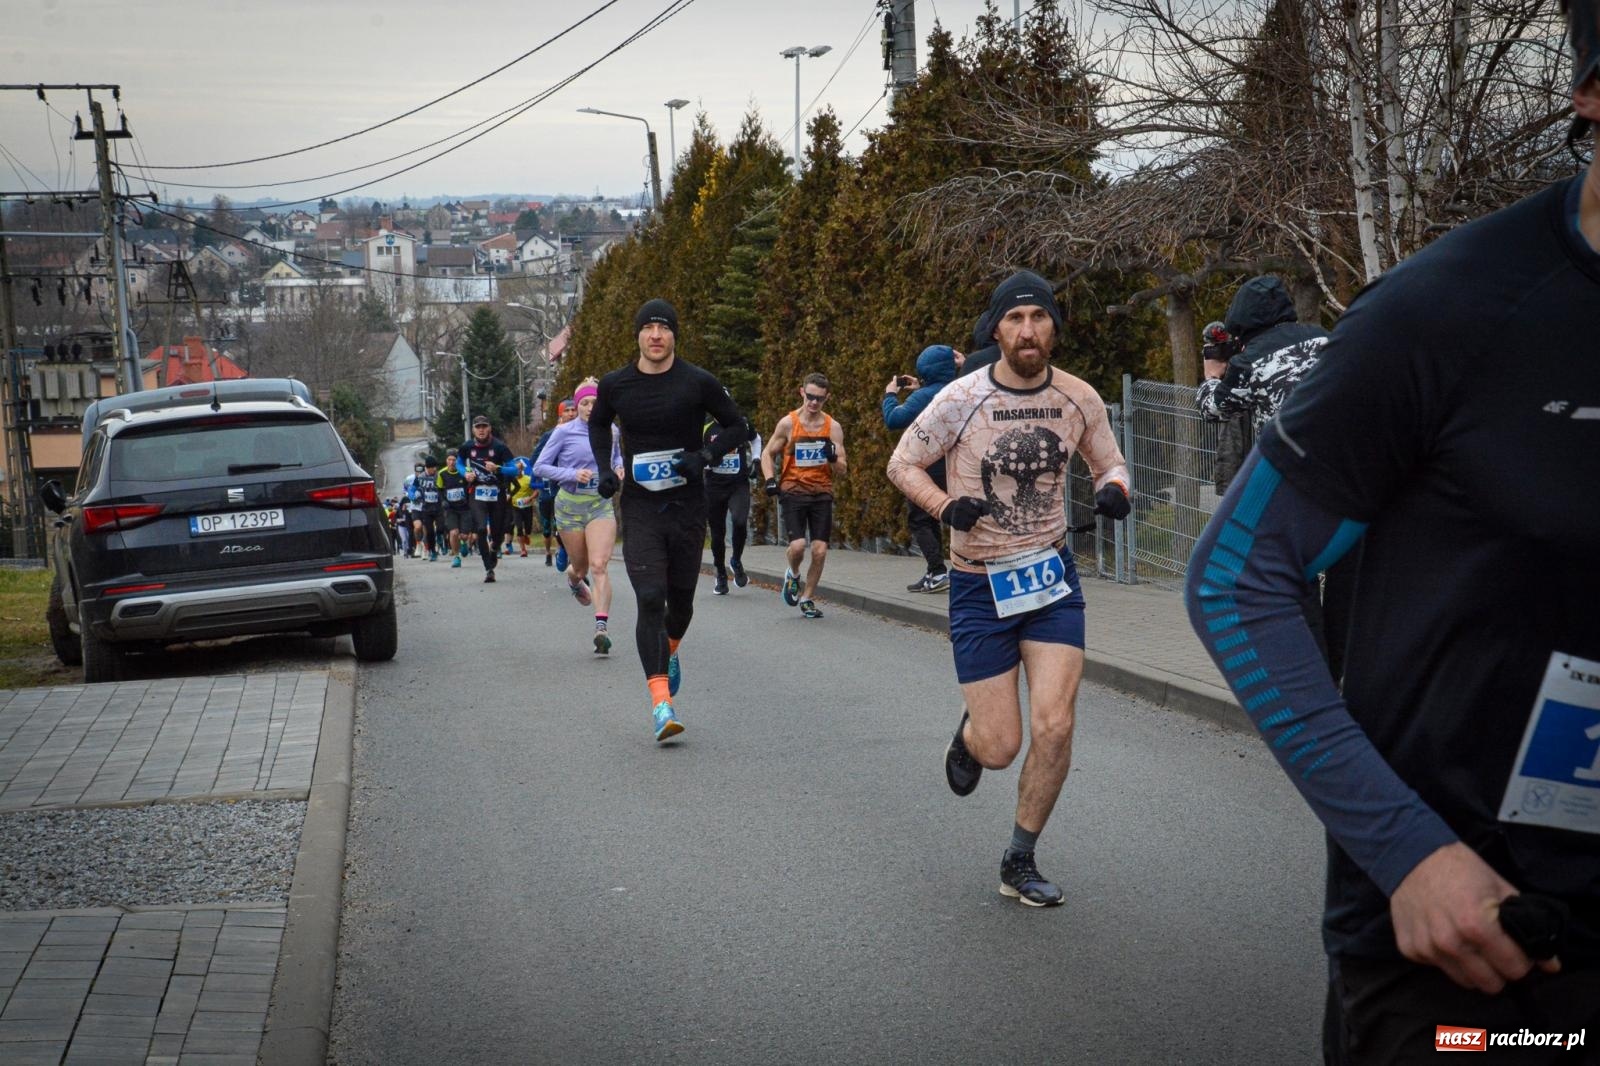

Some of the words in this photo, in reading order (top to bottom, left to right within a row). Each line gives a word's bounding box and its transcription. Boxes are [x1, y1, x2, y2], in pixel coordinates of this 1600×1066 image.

[1542, 400, 1569, 413] 4F
[648, 461, 671, 480] 93
[201, 516, 222, 532] OP
[230, 511, 280, 528] 1239P
[220, 545, 264, 554] Ateca
[1006, 560, 1056, 596] 116
